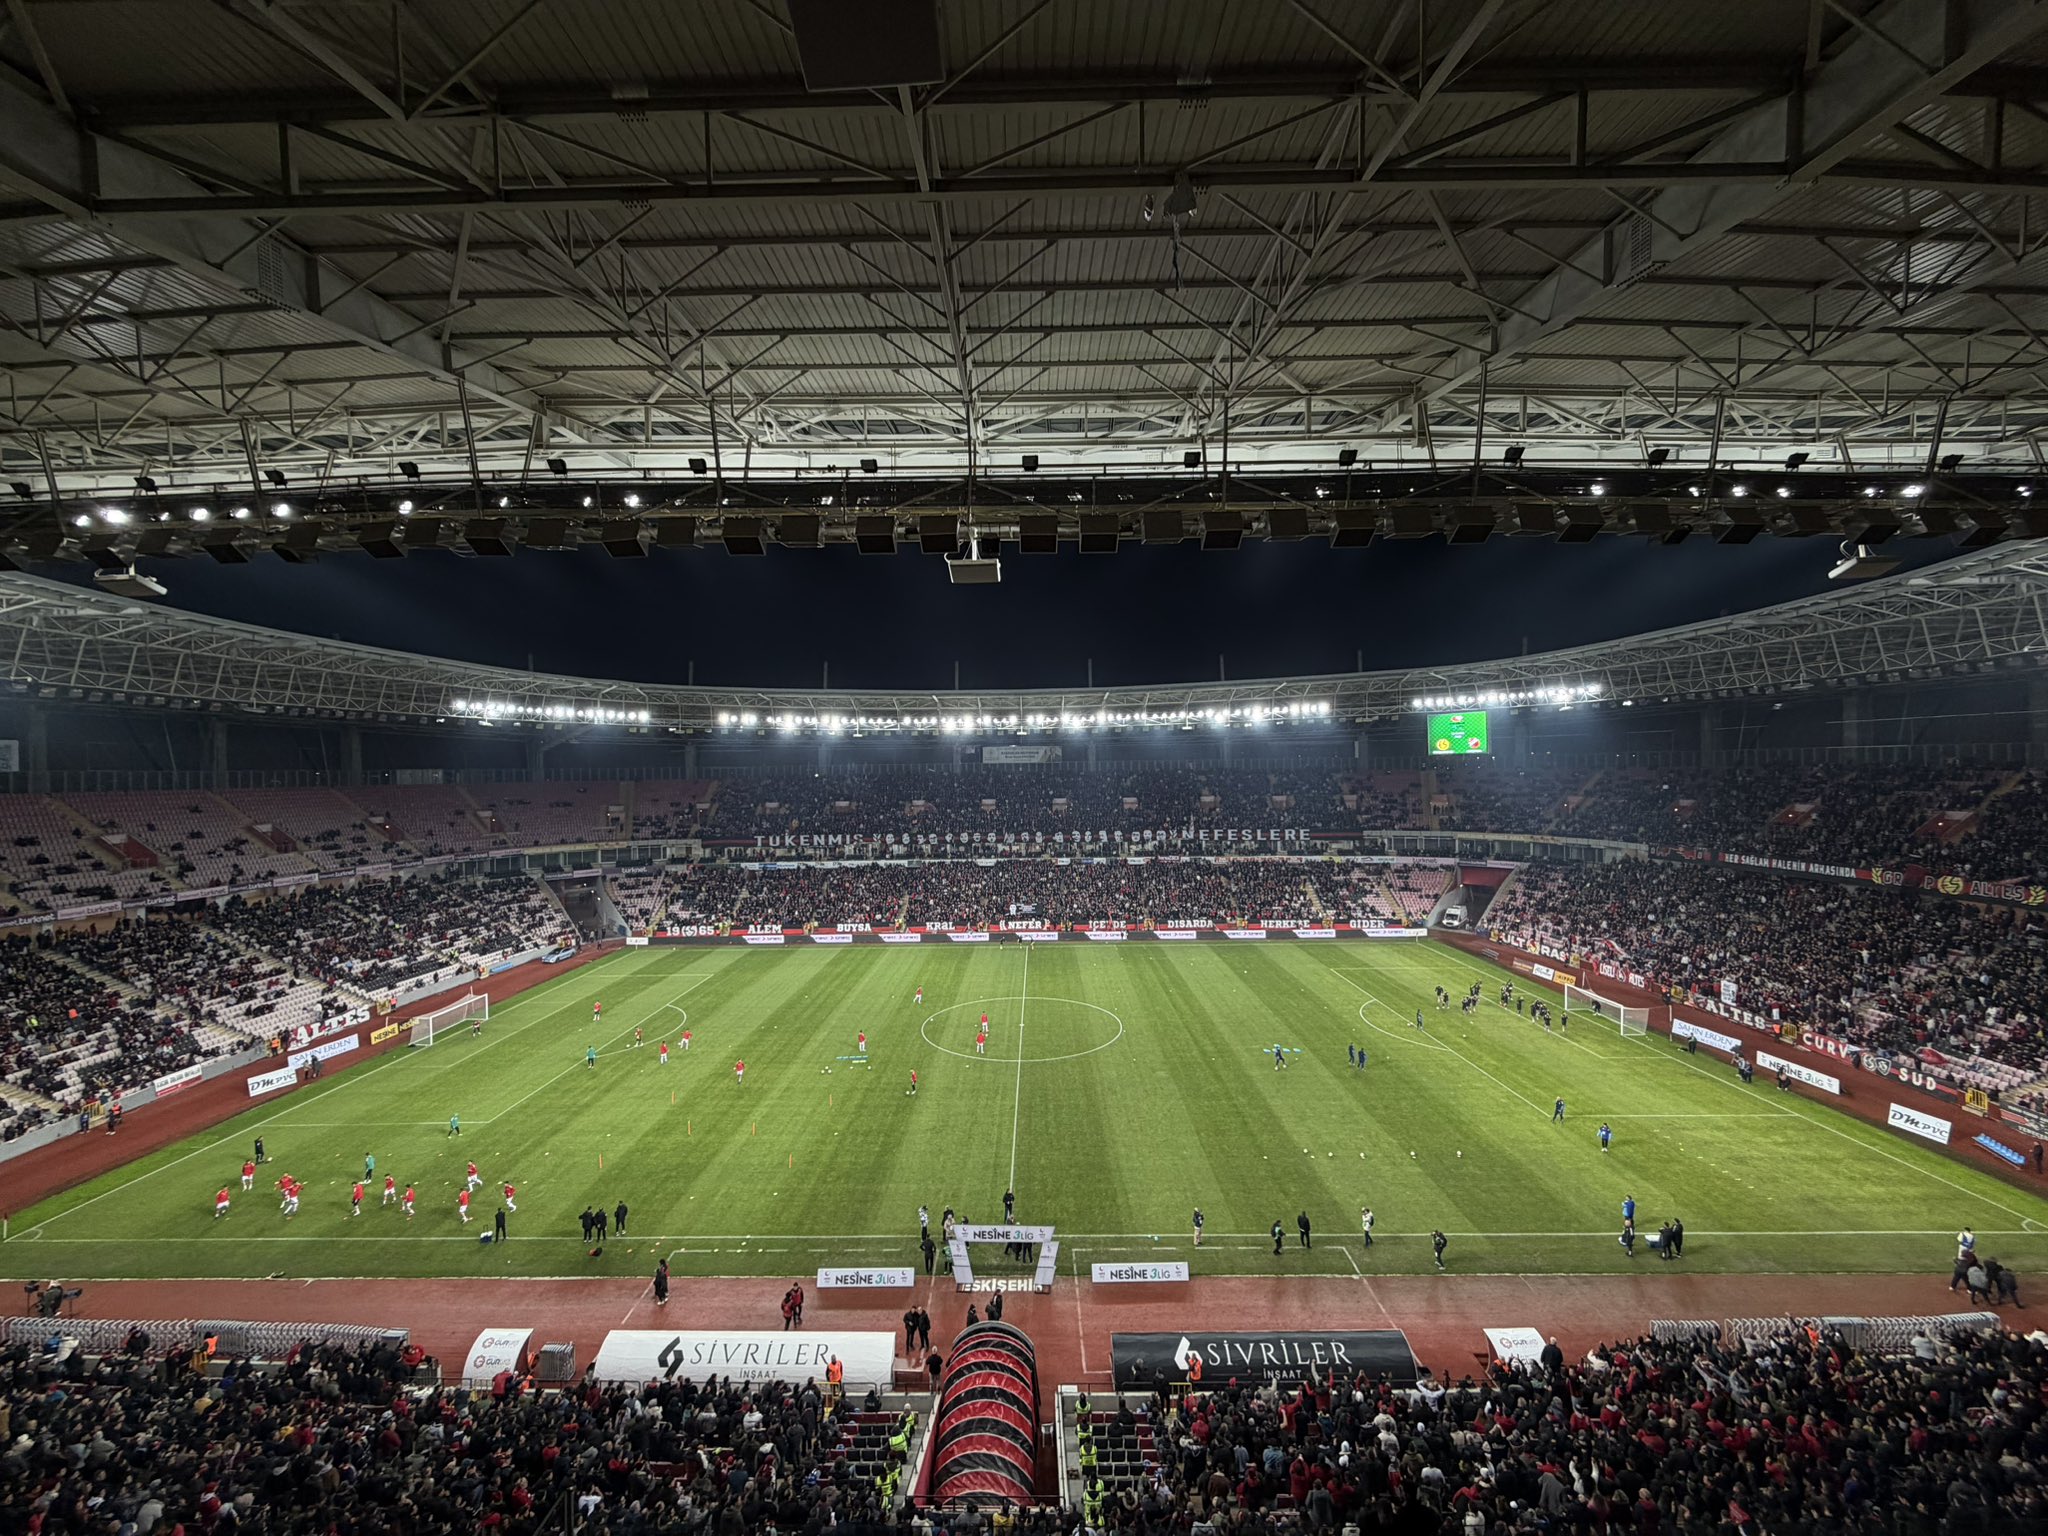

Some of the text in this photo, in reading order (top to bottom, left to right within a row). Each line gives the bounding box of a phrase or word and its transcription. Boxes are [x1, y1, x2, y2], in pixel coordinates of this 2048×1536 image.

[1182, 829, 1310, 840] NEFESLERE
[1883, 871, 1935, 889] GRP
[1705, 1000, 1766, 1030] ALTES
[1803, 1033, 1848, 1058] CURV
[1899, 1067, 1937, 1090] SUD
[690, 1339, 829, 1364] SİVRİLER
[1207, 1339, 1352, 1366] SİVRİLER
